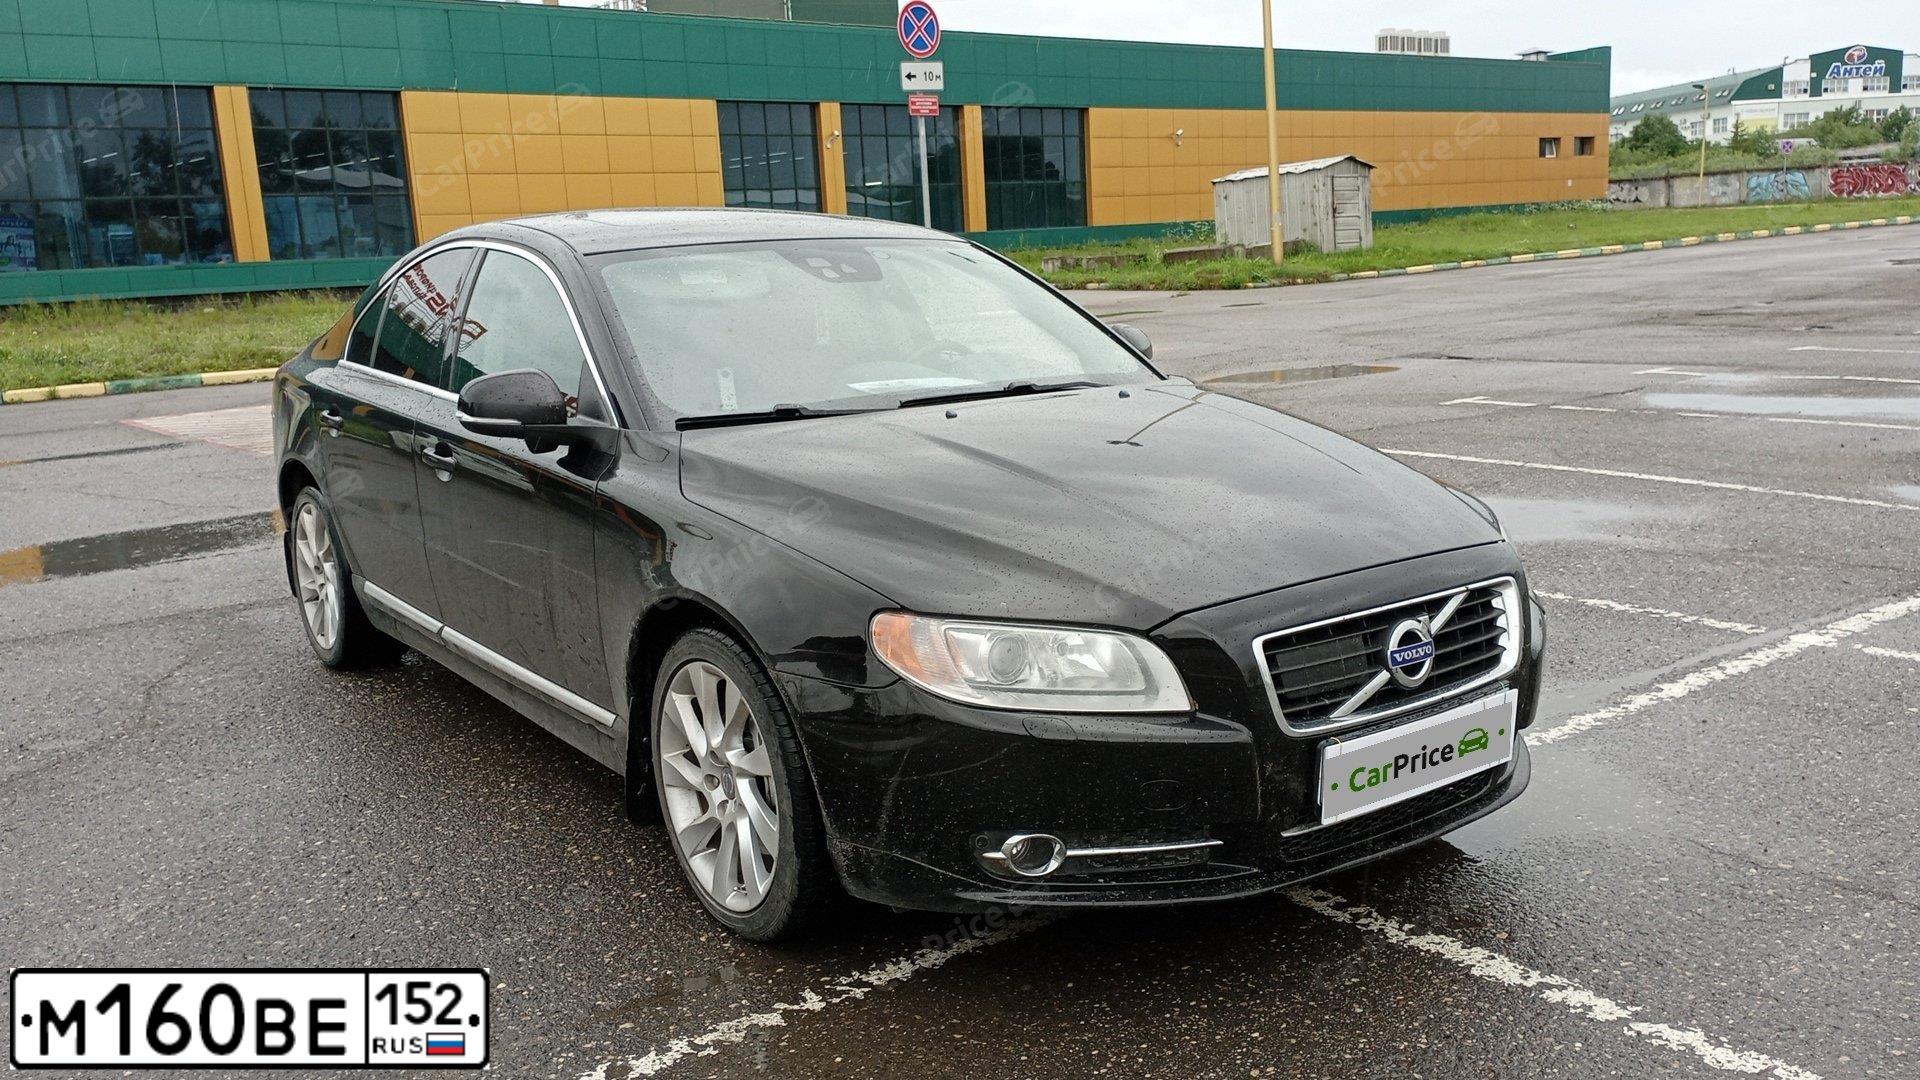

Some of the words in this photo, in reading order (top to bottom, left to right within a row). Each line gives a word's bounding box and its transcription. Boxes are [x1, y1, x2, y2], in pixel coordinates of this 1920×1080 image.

[924, 71, 934, 81] 10
[1826, 59, 1885, 78] Антей
[1394, 645, 1432, 661] VOLVO
